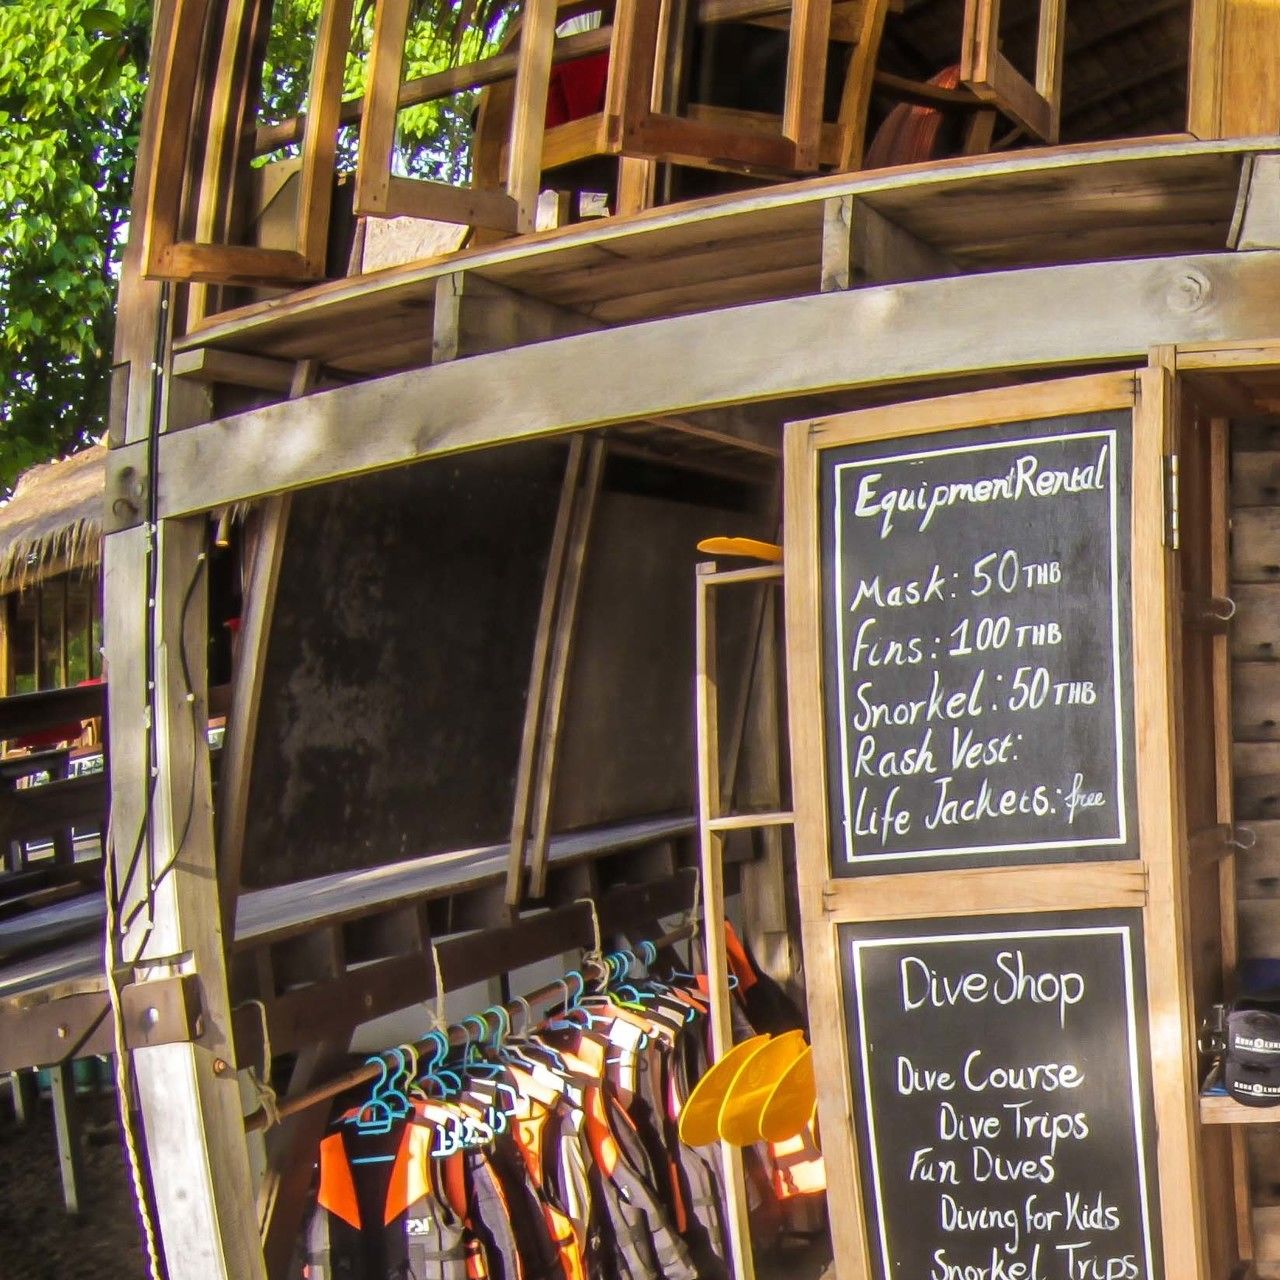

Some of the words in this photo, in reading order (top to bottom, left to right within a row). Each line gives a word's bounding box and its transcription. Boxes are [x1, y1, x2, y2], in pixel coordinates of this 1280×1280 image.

[850, 565, 958, 612] Mask:
[949, 617, 1010, 656] 100
[1015, 622, 1062, 648] THB
[853, 670, 1004, 732] Snorkel:
[854, 728, 937, 778] Rash
[952, 727, 1023, 771] Vest:
[855, 786, 911, 847] Life
[925, 777, 1062, 830] Jackets:
[1065, 772, 1106, 824] free
[901, 956, 988, 1012] Dive
[994, 950, 1084, 1029] Shop
[897, 1056, 956, 1095] Dive
[964, 1050, 1084, 1091] Course
[939, 1102, 1000, 1141] Dive
[1003, 1101, 1089, 1155] Trips
[910, 1148, 960, 1185] Fun
[972, 1147, 1055, 1184] Dives
[941, 1194, 1018, 1255] Diving
[1025, 1195, 1062, 1231] for
[1066, 1191, 1120, 1230] Kids
